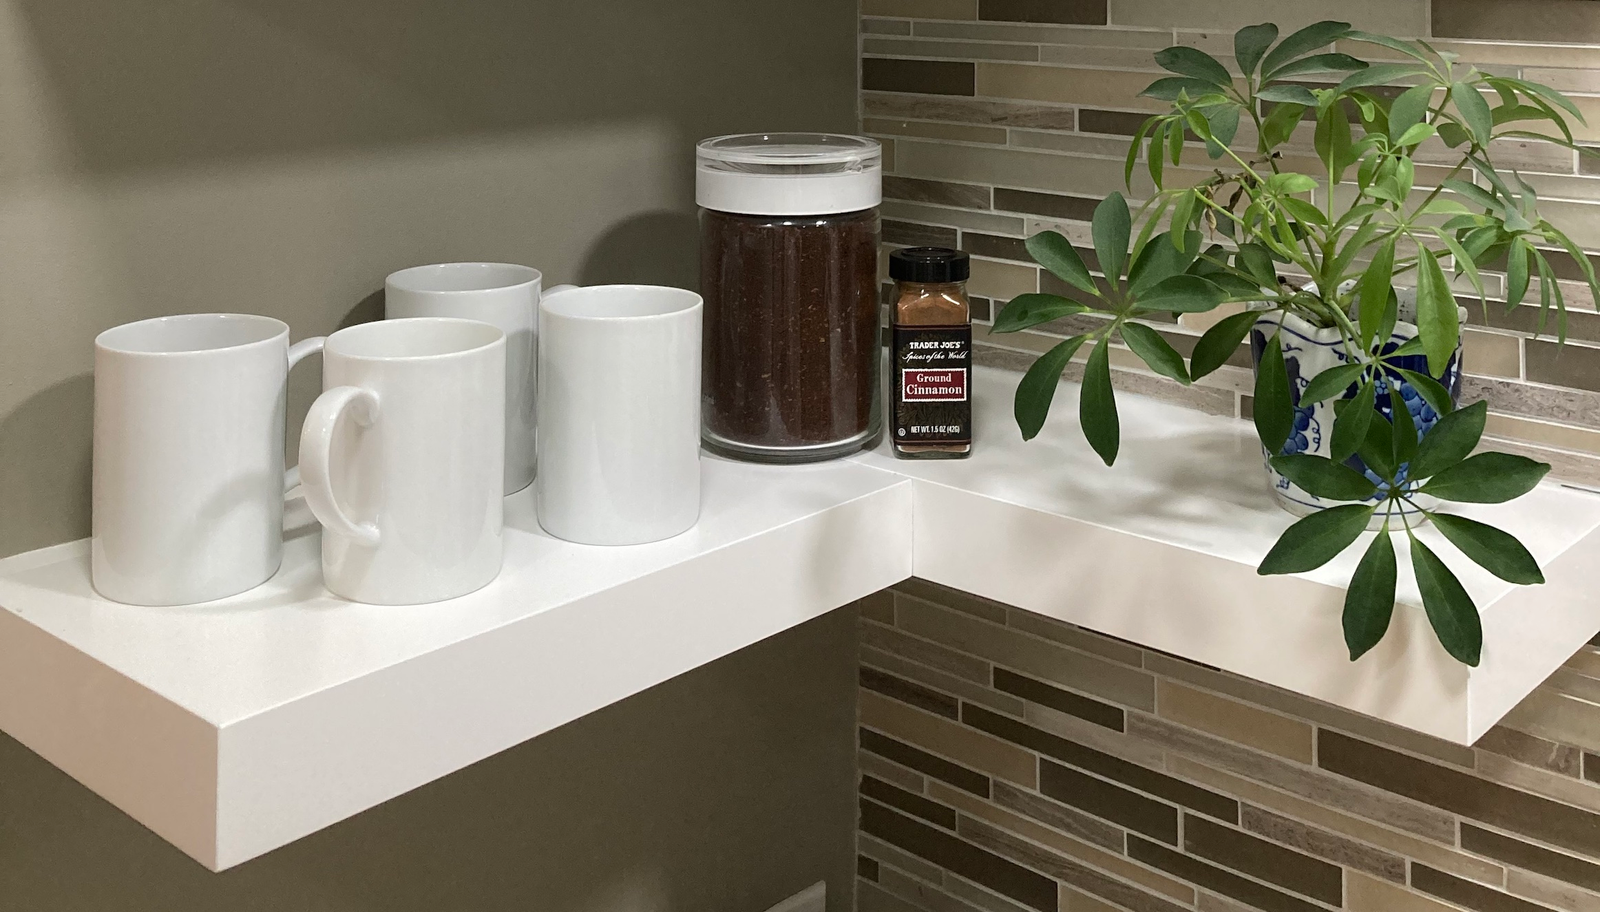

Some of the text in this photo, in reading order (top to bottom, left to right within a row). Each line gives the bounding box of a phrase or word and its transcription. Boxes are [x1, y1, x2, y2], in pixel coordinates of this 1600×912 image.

[909, 341, 961, 349] TRADER JOE'S
[902, 350, 968, 363] Spices of the World
[916, 373, 952, 383] Ground
[906, 384, 962, 395] Cinnamon
[910, 425, 920, 433] NET
